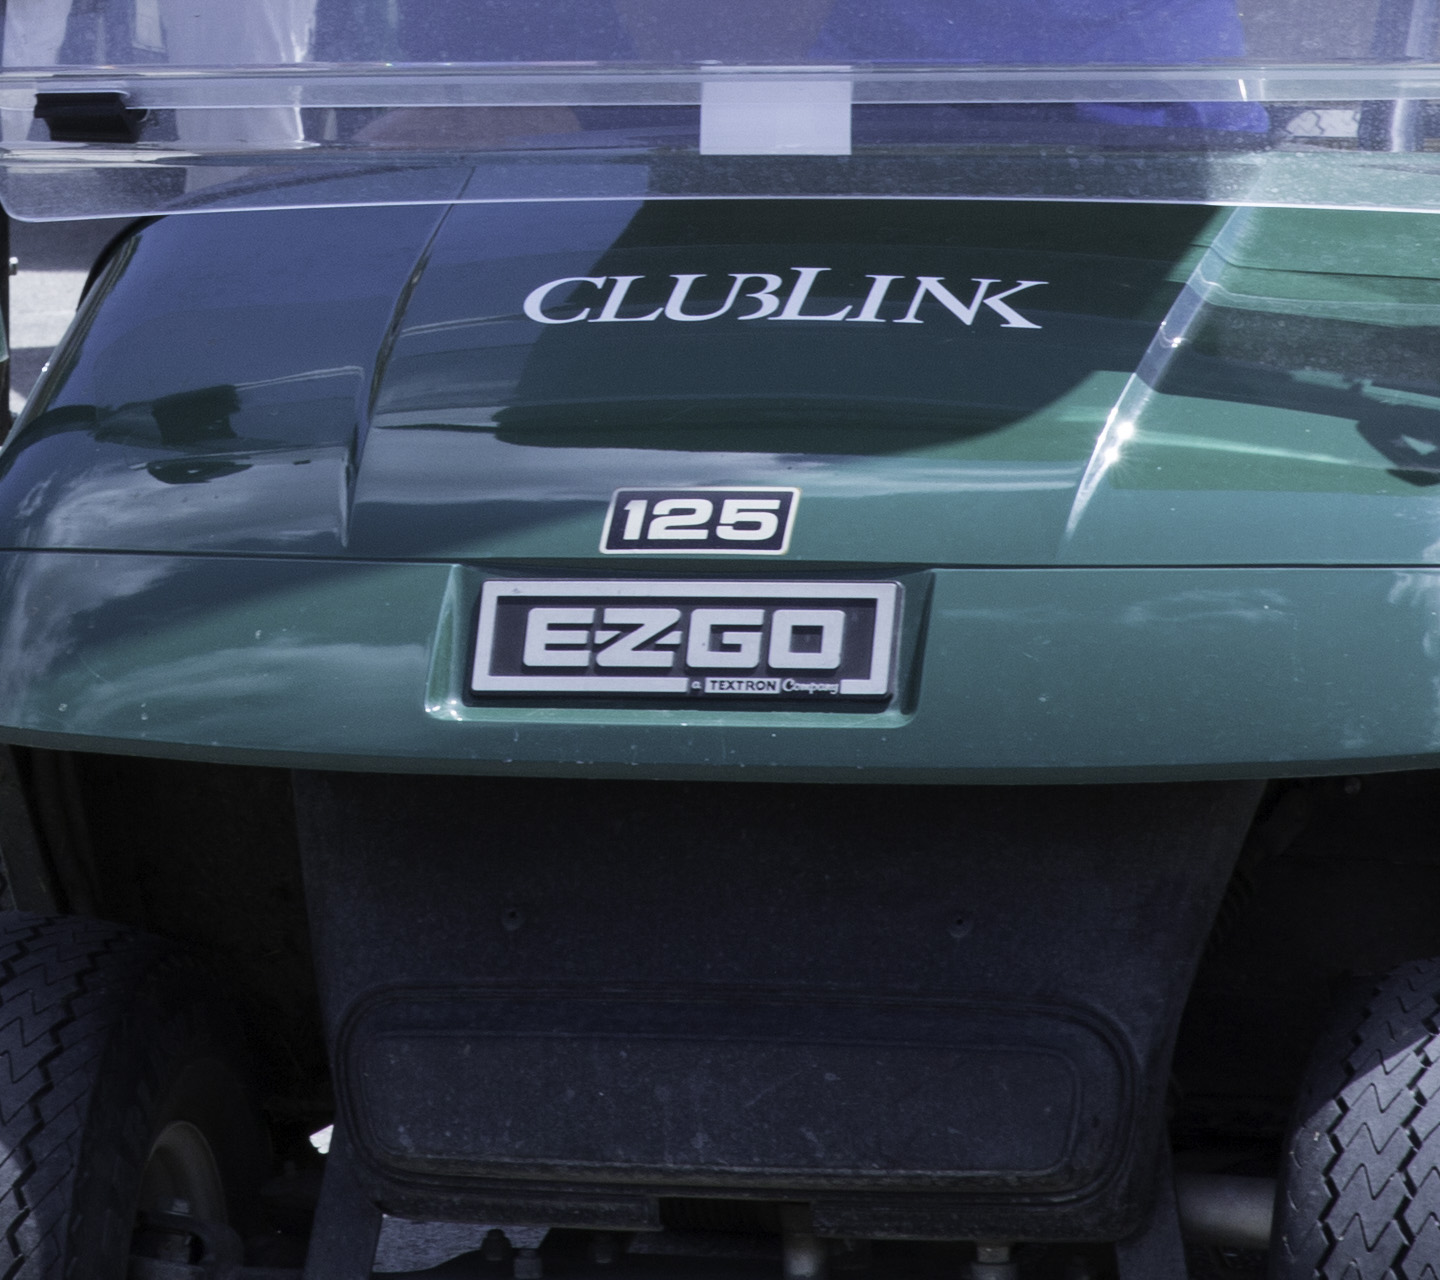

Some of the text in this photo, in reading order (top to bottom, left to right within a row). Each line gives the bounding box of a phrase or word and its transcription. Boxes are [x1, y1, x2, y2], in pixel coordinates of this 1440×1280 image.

[523, 267, 1049, 329] CLUBLINK
[622, 499, 781, 541] 125
[710, 680, 776, 691] TEXTRON
[782, 678, 839, 694] Company
